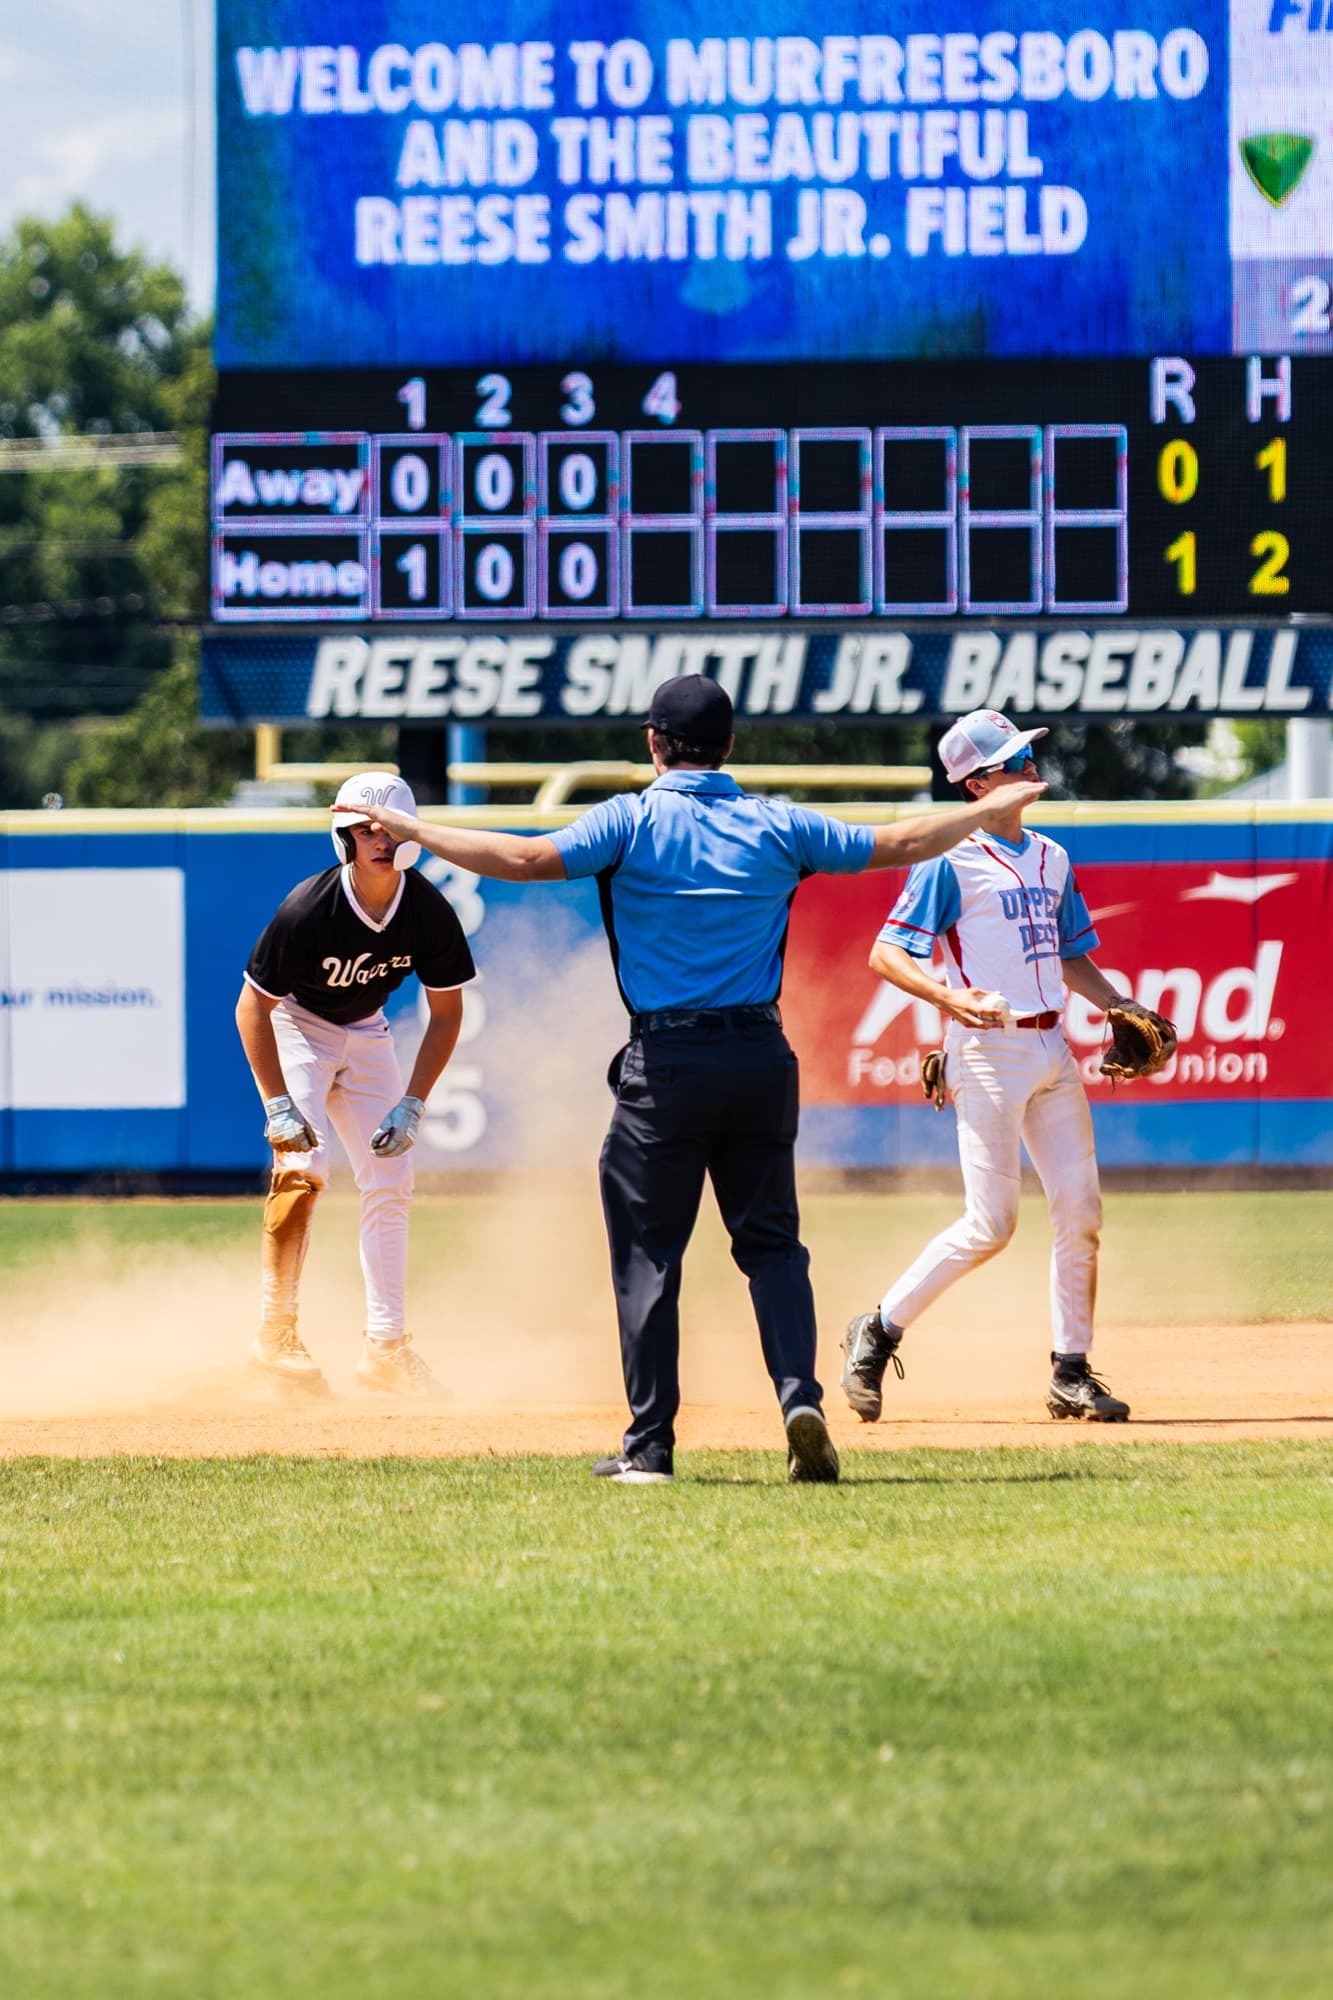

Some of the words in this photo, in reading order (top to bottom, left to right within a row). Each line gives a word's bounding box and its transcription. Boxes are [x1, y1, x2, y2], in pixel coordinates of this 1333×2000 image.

[236, 42, 555, 116] WELCOME
[569, 39, 654, 109] TO
[667, 28, 1209, 106] MURFREESBORO
[397, 119, 539, 188] AND
[551, 116, 674, 185] THE
[687, 109, 1044, 183] BEAUTIFUL
[355, 195, 551, 265] REESE
[564, 190, 773, 263] SMITH
[786, 189, 891, 260] JR.
[905, 185, 1089, 257] FIELD
[400, 377, 427, 430] 1
[475, 373, 512, 427] 2
[561, 371, 595, 425] 3
[643, 371, 682, 423] 4
[1150, 356, 1197, 424] R
[1247, 355, 1292, 423] H
[216, 459, 364, 514] Away
[391, 454, 430, 511] 0
[475, 453, 514, 510] 0
[560, 453, 598, 510] 0
[1158, 438, 1200, 504] 0
[1257, 437, 1288, 502] 1
[220, 551, 369, 597] Home
[398, 544, 427, 600] 1
[475, 543, 514, 600] 0
[560, 542, 598, 599] 0
[1165, 531, 1197, 595] 1
[1249, 530, 1291, 595] 2
[306, 636, 555, 719] REESE
[561, 634, 808, 717] SMITH
[811, 633, 924, 714] JR.
[940, 630, 1312, 713] BASEBALL
[998, 886, 1060, 921] UPPE
[1018, 923, 1058, 954] DEC
